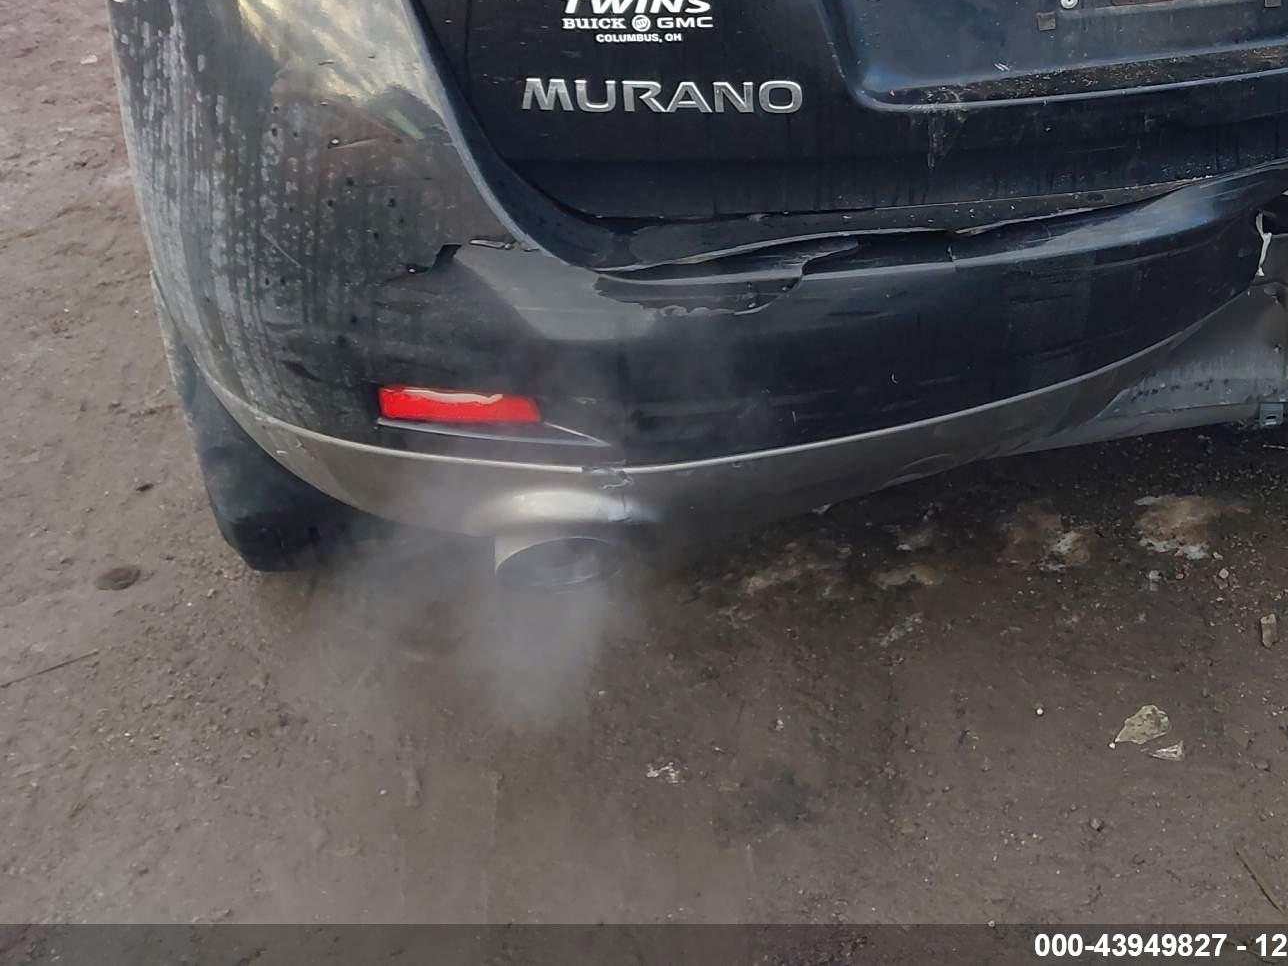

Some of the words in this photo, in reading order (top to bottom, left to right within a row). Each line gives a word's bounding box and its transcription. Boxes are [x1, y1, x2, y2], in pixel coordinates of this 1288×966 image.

[562, 17, 627, 30] BUICK
[656, 16, 714, 29] GMC
[596, 33, 663, 44] COLUMBUS,
[665, 32, 682, 43] OH
[522, 78, 803, 114] MURANO
